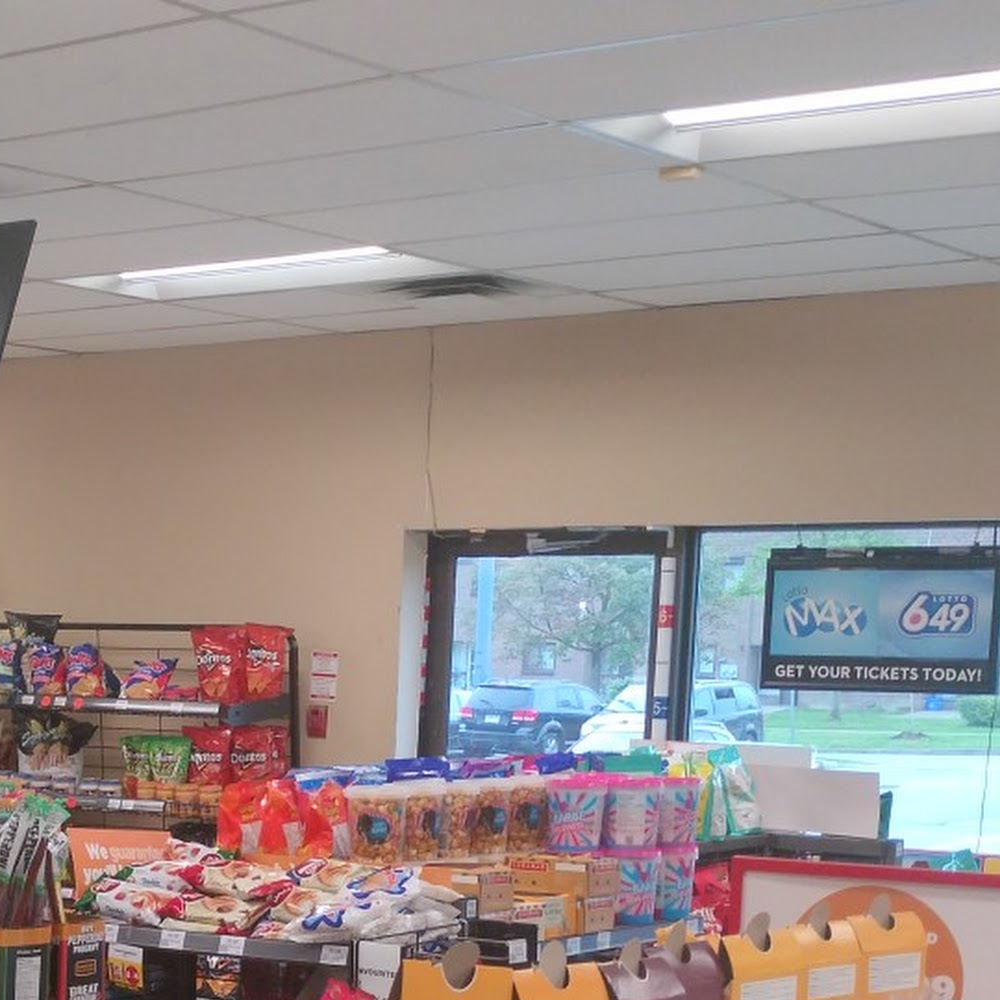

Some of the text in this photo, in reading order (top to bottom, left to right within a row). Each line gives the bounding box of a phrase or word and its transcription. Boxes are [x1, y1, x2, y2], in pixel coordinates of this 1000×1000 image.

[785, 597, 862, 636] MAX
[902, 595, 970, 632] 649
[775, 665, 982, 682] GET YOUR TICKETS TODAY!
[231, 752, 266, 763] Doritos
[85, 844, 108, 859] We
